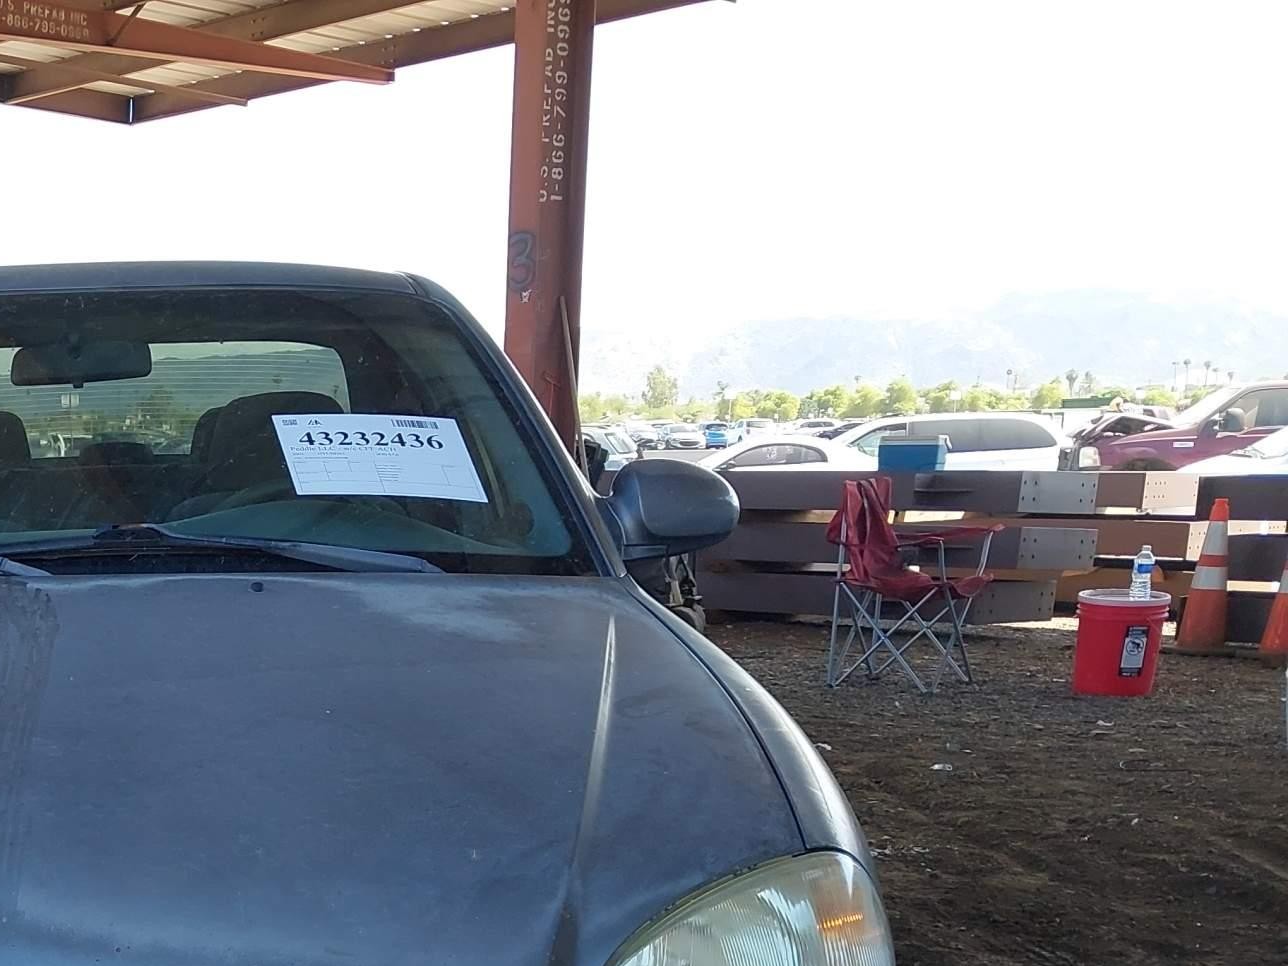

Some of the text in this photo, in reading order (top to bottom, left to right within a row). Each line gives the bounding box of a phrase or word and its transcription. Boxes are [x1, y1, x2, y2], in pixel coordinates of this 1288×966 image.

[23, 1, 65, 21] PREFAB
[509, 231, 536, 292] 3
[298, 431, 444, 450] 43232436
